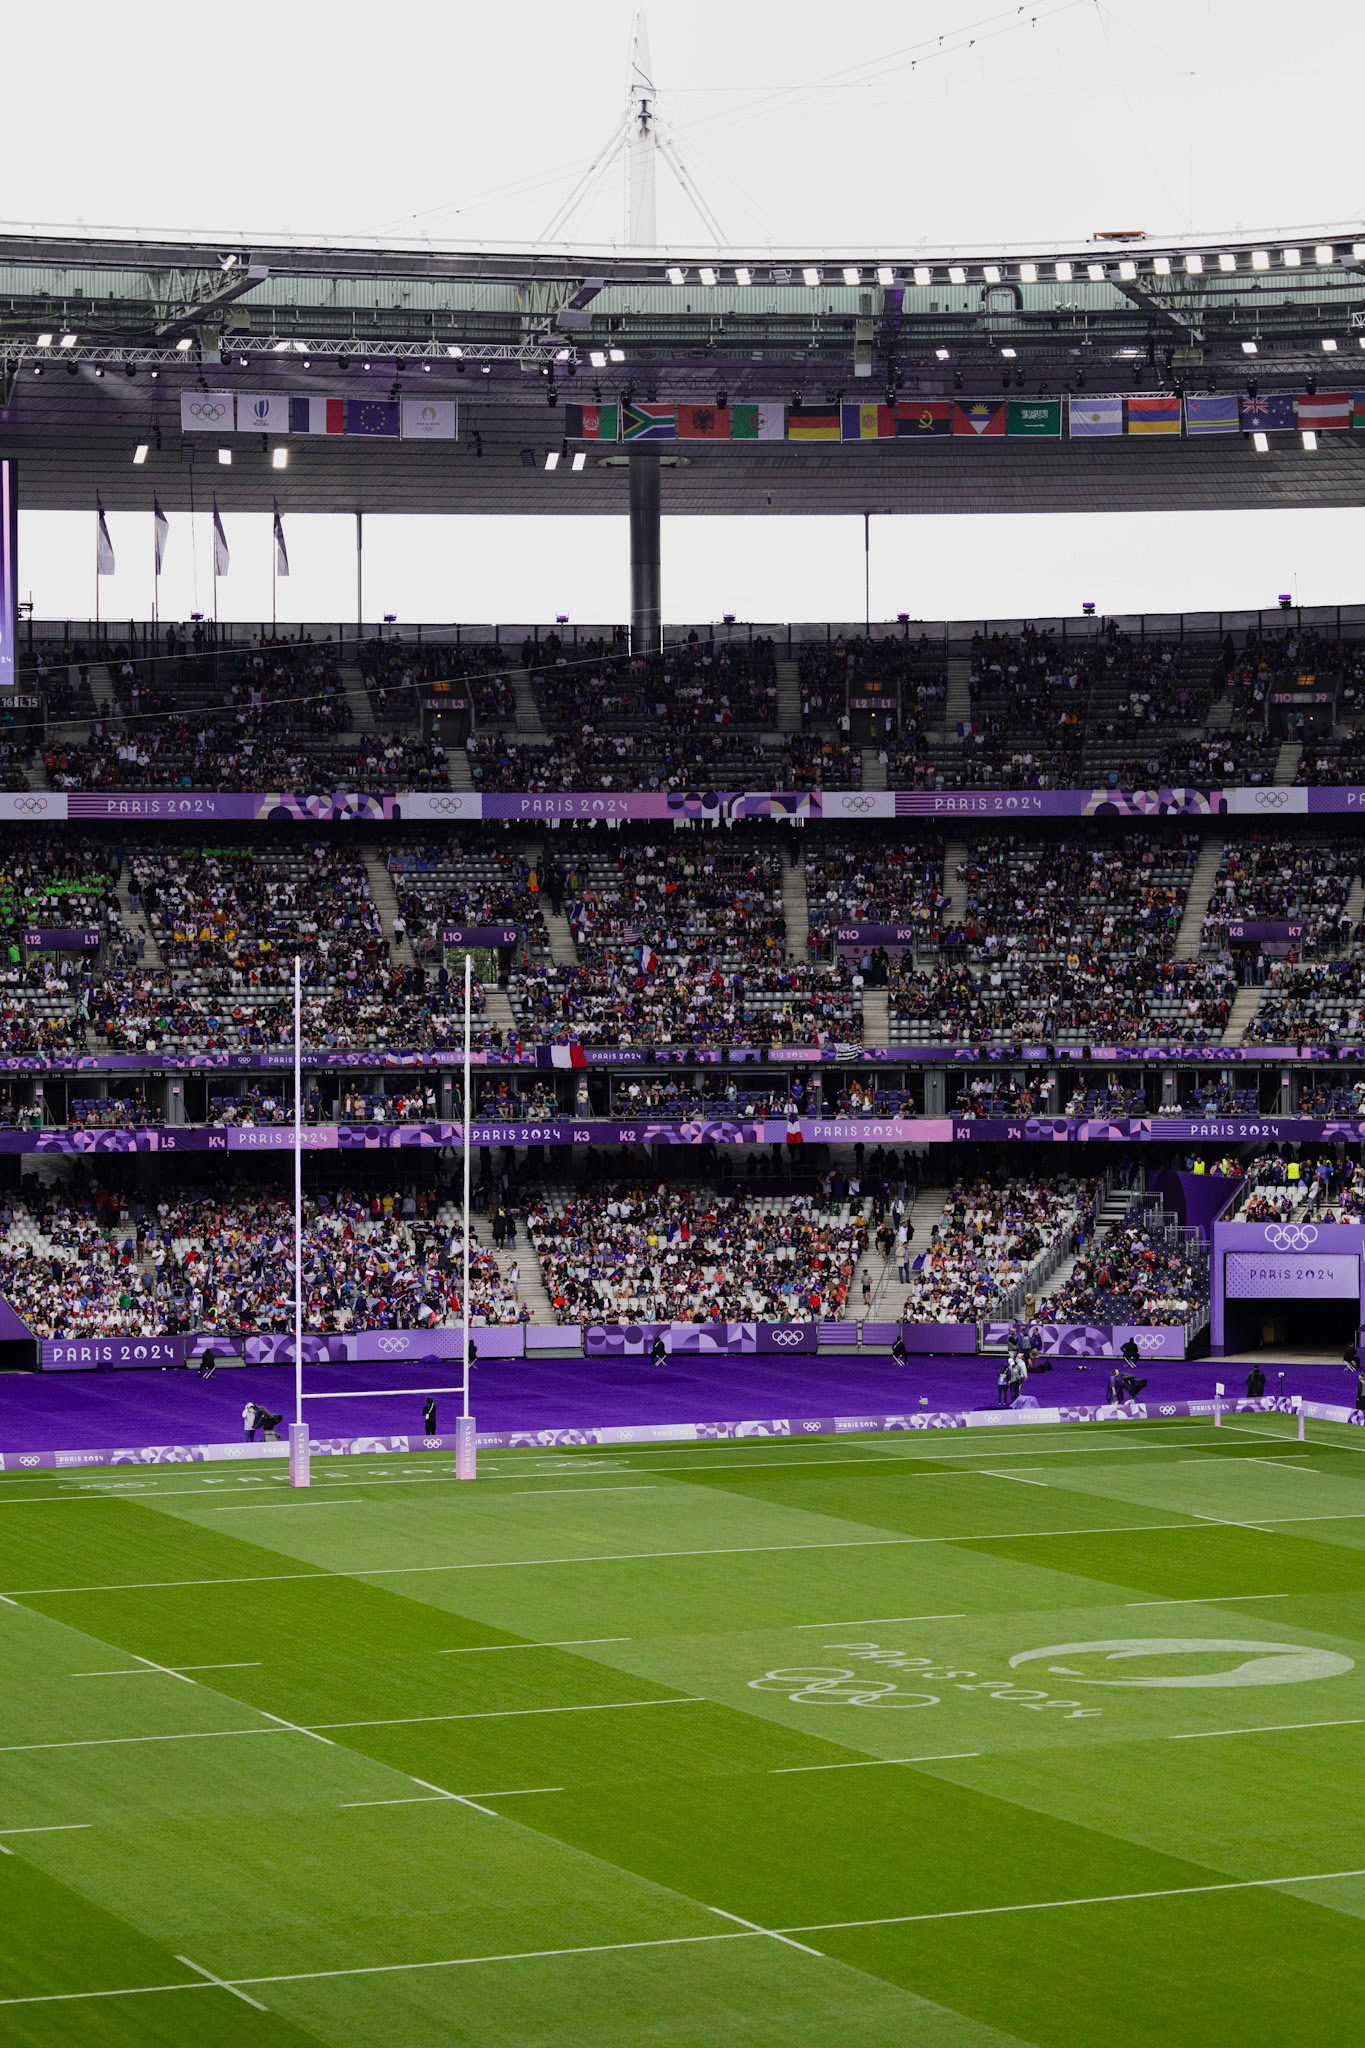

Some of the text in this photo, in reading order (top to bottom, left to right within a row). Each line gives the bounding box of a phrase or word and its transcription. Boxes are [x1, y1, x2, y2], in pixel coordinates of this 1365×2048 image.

[19, 698, 38, 707] L15
[855, 699, 891, 708] L2 L1
[1274, 693, 1327, 703] J10 J9
[427, 699, 464, 709] L4 L3
[107, 800, 215, 813] PARIS 2024
[521, 800, 628, 812] PARIS 2024
[935, 797, 1042, 810] PARIS 2024
[443, 932, 516, 942] L10 L9
[838, 930, 912, 940] K10 K9
[1229, 927, 1302, 937] K8 K7
[24, 934, 99, 945] L12 L11
[268, 1056, 293, 1064] PARIS
[472, 1129, 561, 1141] PARIS 2024
[573, 1130, 636, 1142] K3 K2
[814, 1126, 903, 1137] PARIS 2024
[956, 1127, 1021, 1139] K1 J4
[1191, 1125, 1279, 1136] PARIS 2024
[161, 1136, 226, 1148] L5 K4
[239, 1133, 282, 1144] PARIS
[1250, 1269, 1334, 1280] PARIS 2024
[53, 1345, 174, 1362] PARIS 2024
[822, 1642, 1104, 1719] PARIS 2024
